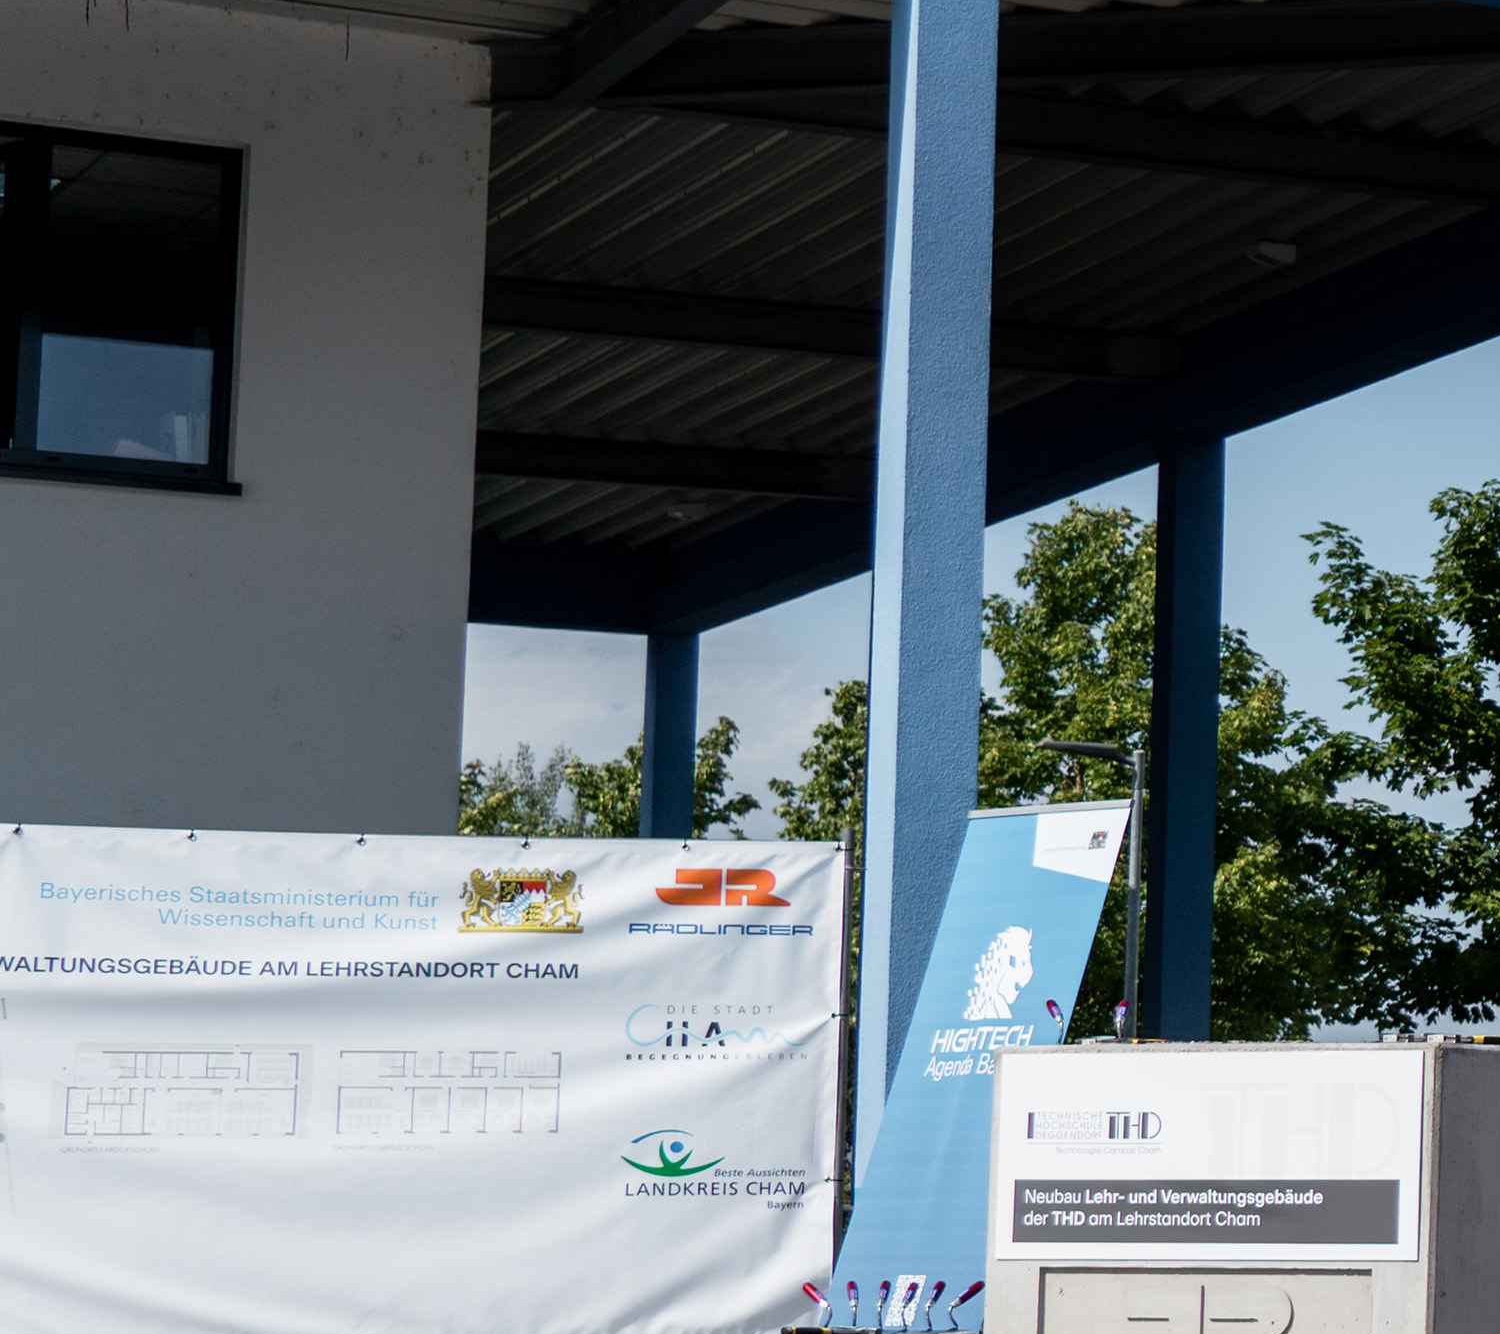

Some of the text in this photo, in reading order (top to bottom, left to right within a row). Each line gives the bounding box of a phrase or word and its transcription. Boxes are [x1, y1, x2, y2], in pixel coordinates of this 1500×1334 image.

[40, 881, 440, 909] Bayerisches Staatsministerium für
[158, 908, 439, 932] Wissenschaft und Kunst
[628, 922, 814, 936] RÄDLINGER
[259, 961, 298, 977] AM
[305, 960, 501, 979] LEHRSTANDORT
[506, 962, 580, 981] CHAM
[667, 1005, 775, 1014] DIE STADT
[930, 1024, 1035, 1055] HIGHTECH
[924, 1055, 974, 1082] Agenda
[1037, 1112, 1104, 1120] TECHNISCHE
[1036, 1121, 1103, 1130] HOCHSCHULE
[1035, 1131, 1103, 1140] DEGGENDORF
[1055, 1147, 1102, 1156] Technologie
[1104, 1147, 1136, 1155] Campus
[714, 1168, 806, 1178] Beste Aussichten
[626, 1181, 806, 1197] LANDKREIS CHAM
[767, 1200, 804, 1212] Bayern
[1025, 1189, 1324, 1208] Neubau Lehr- und Verwaltungsgebäude
[1024, 1211, 1261, 1227] der THD am Lehrstandort Cham
